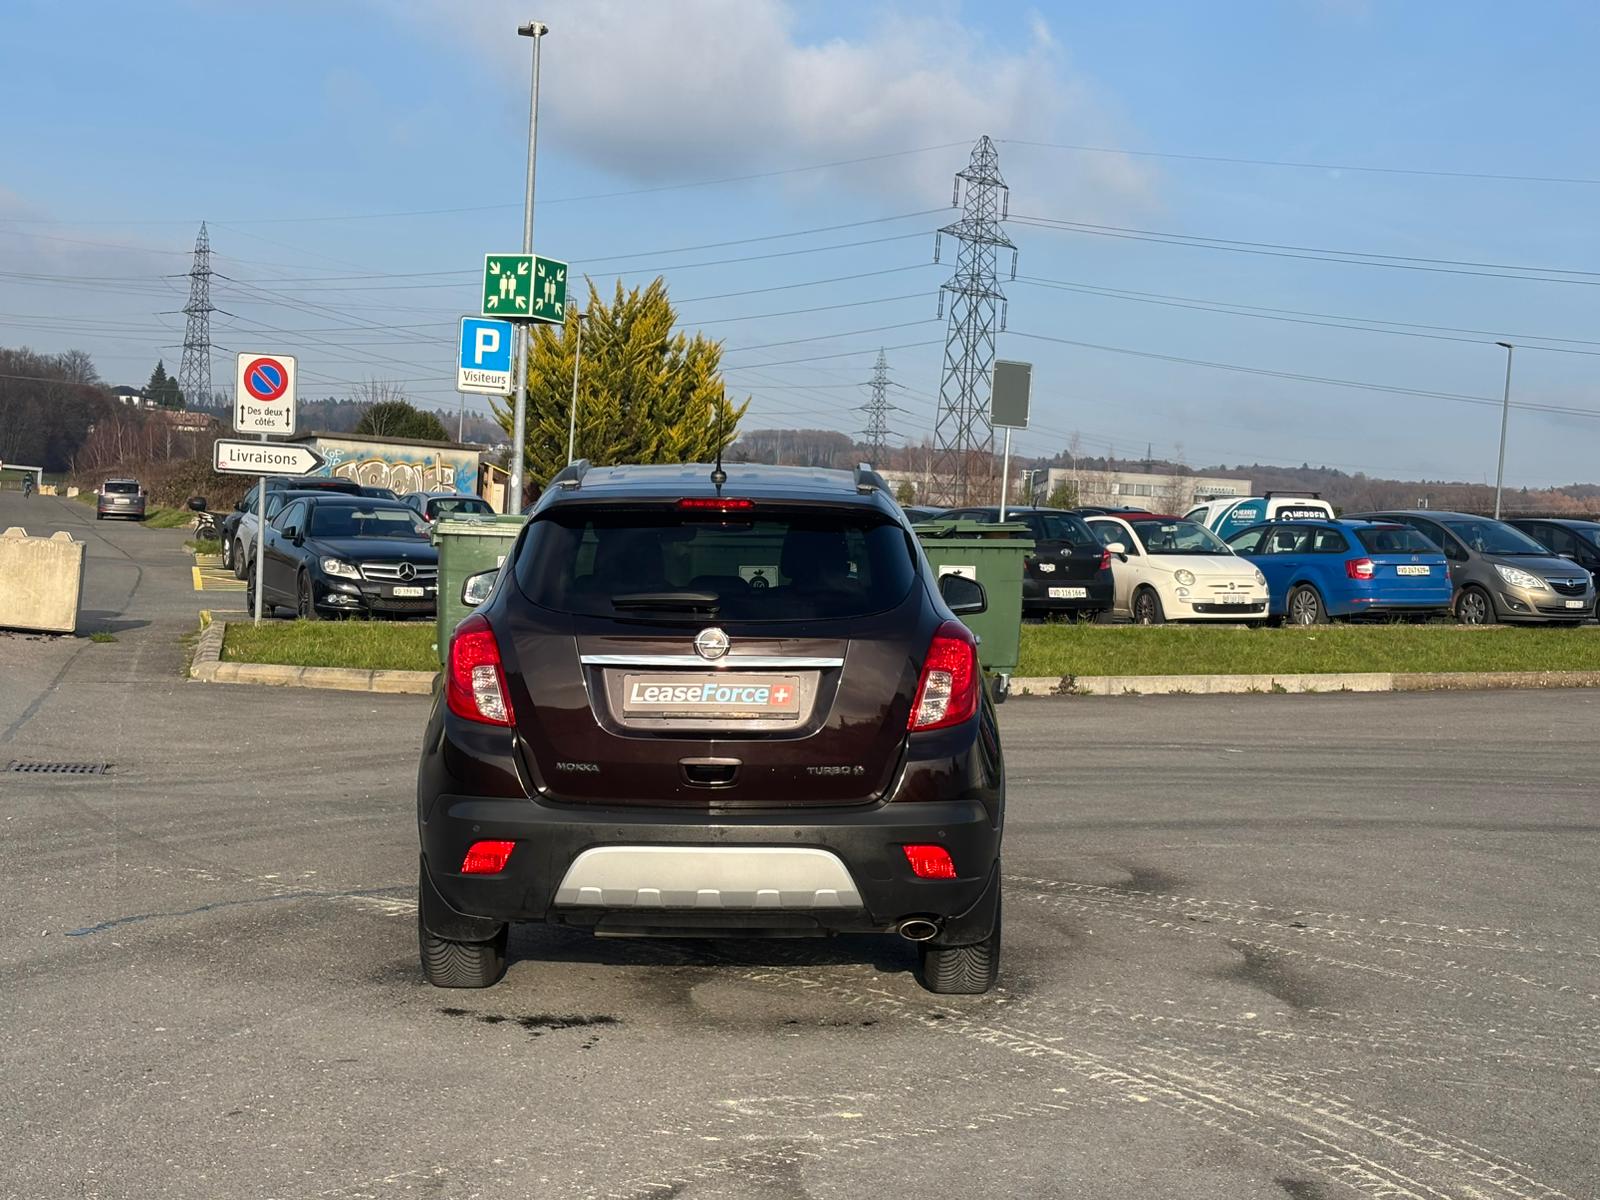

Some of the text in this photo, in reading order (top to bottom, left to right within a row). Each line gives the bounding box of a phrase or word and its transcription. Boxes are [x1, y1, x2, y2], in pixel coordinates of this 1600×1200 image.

[474, 327, 500, 365] P
[463, 370, 506, 384] Visiteurs
[247, 406, 283, 417] Des deux
[254, 417, 276, 427] côtés
[229, 448, 297, 466] Livraisons
[630, 683, 769, 703] LeaseForce
[556, 762, 600, 772] MOKKA
[806, 766, 850, 776] TURBO
